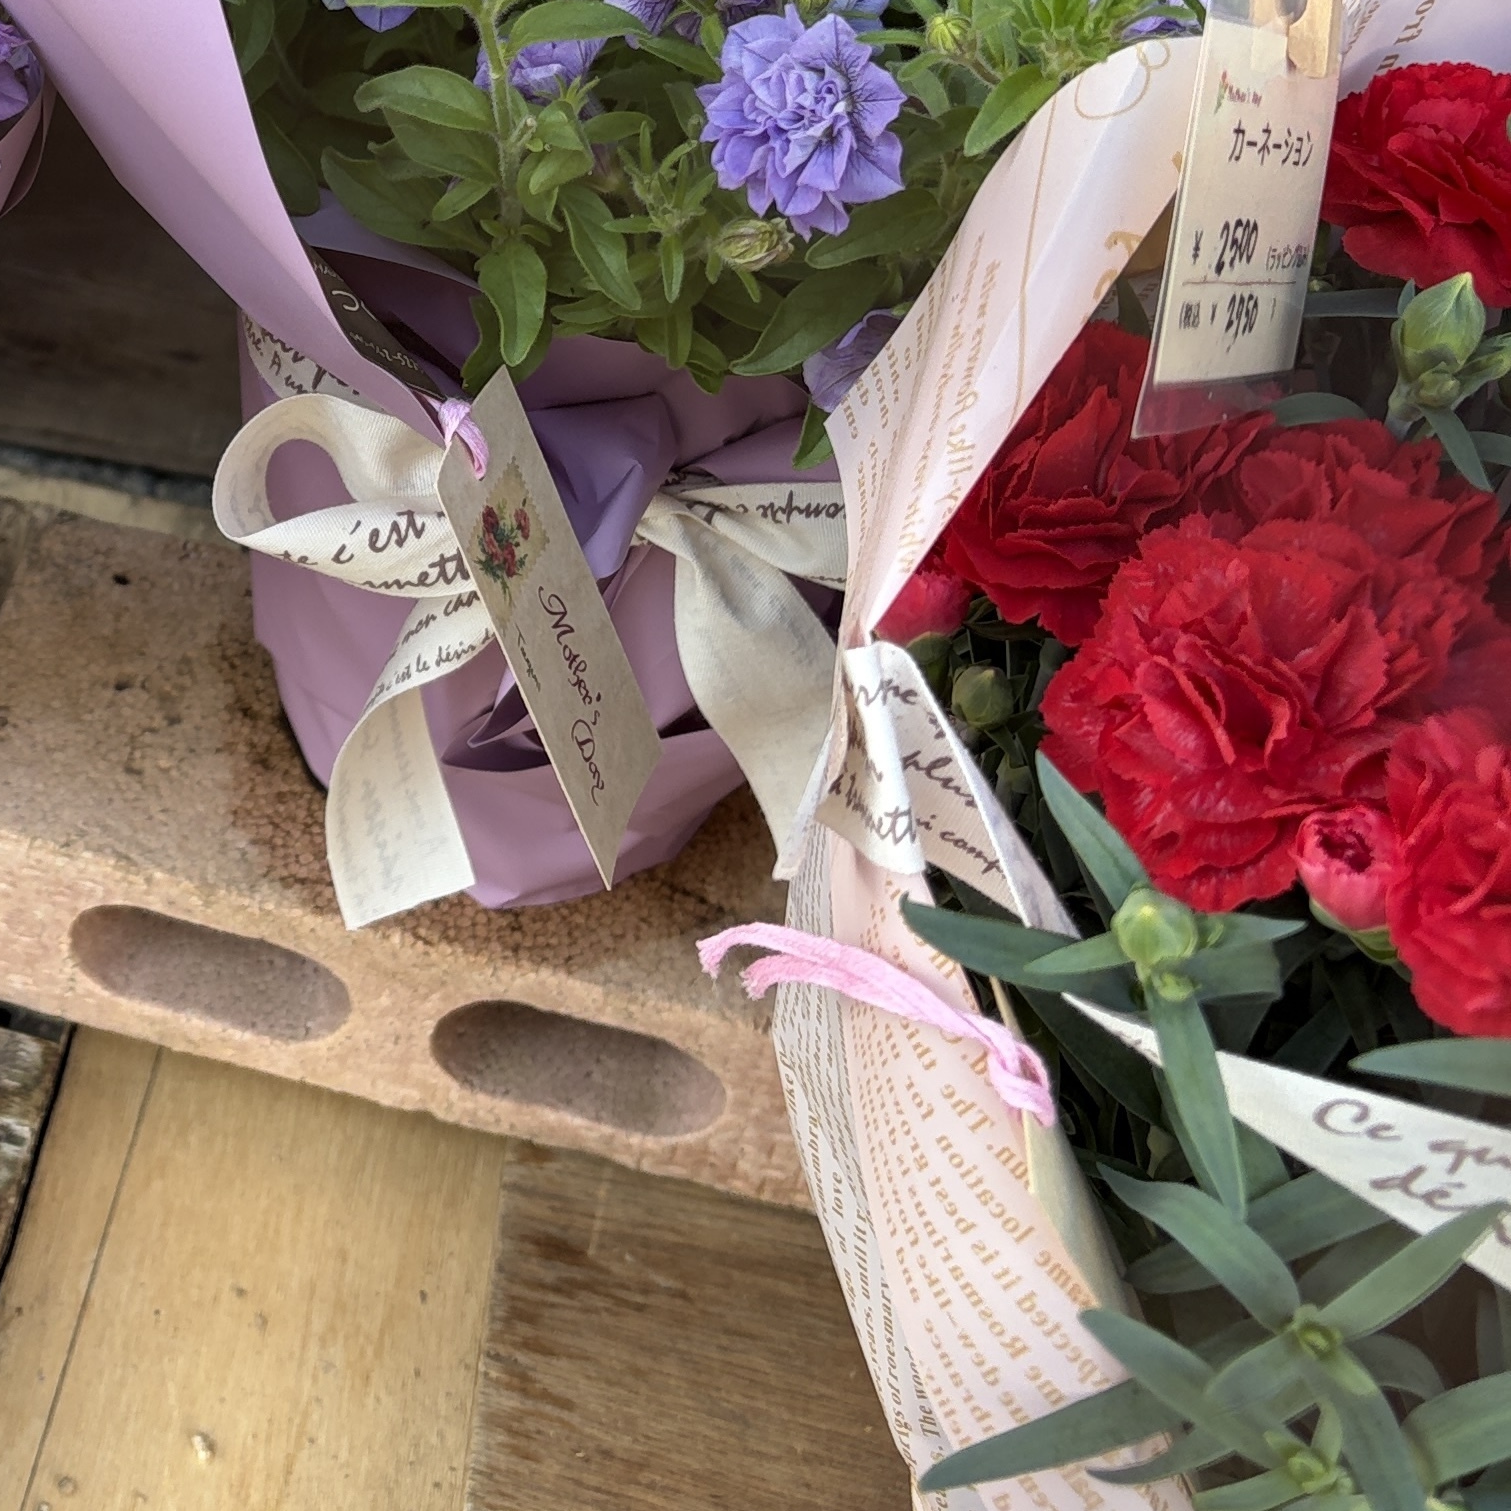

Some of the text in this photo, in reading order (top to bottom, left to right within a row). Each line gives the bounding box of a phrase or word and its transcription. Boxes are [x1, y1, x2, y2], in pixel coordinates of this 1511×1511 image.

[1228, 116, 1314, 167] カーネーション
[538, 586, 607, 807] Mother's Day
